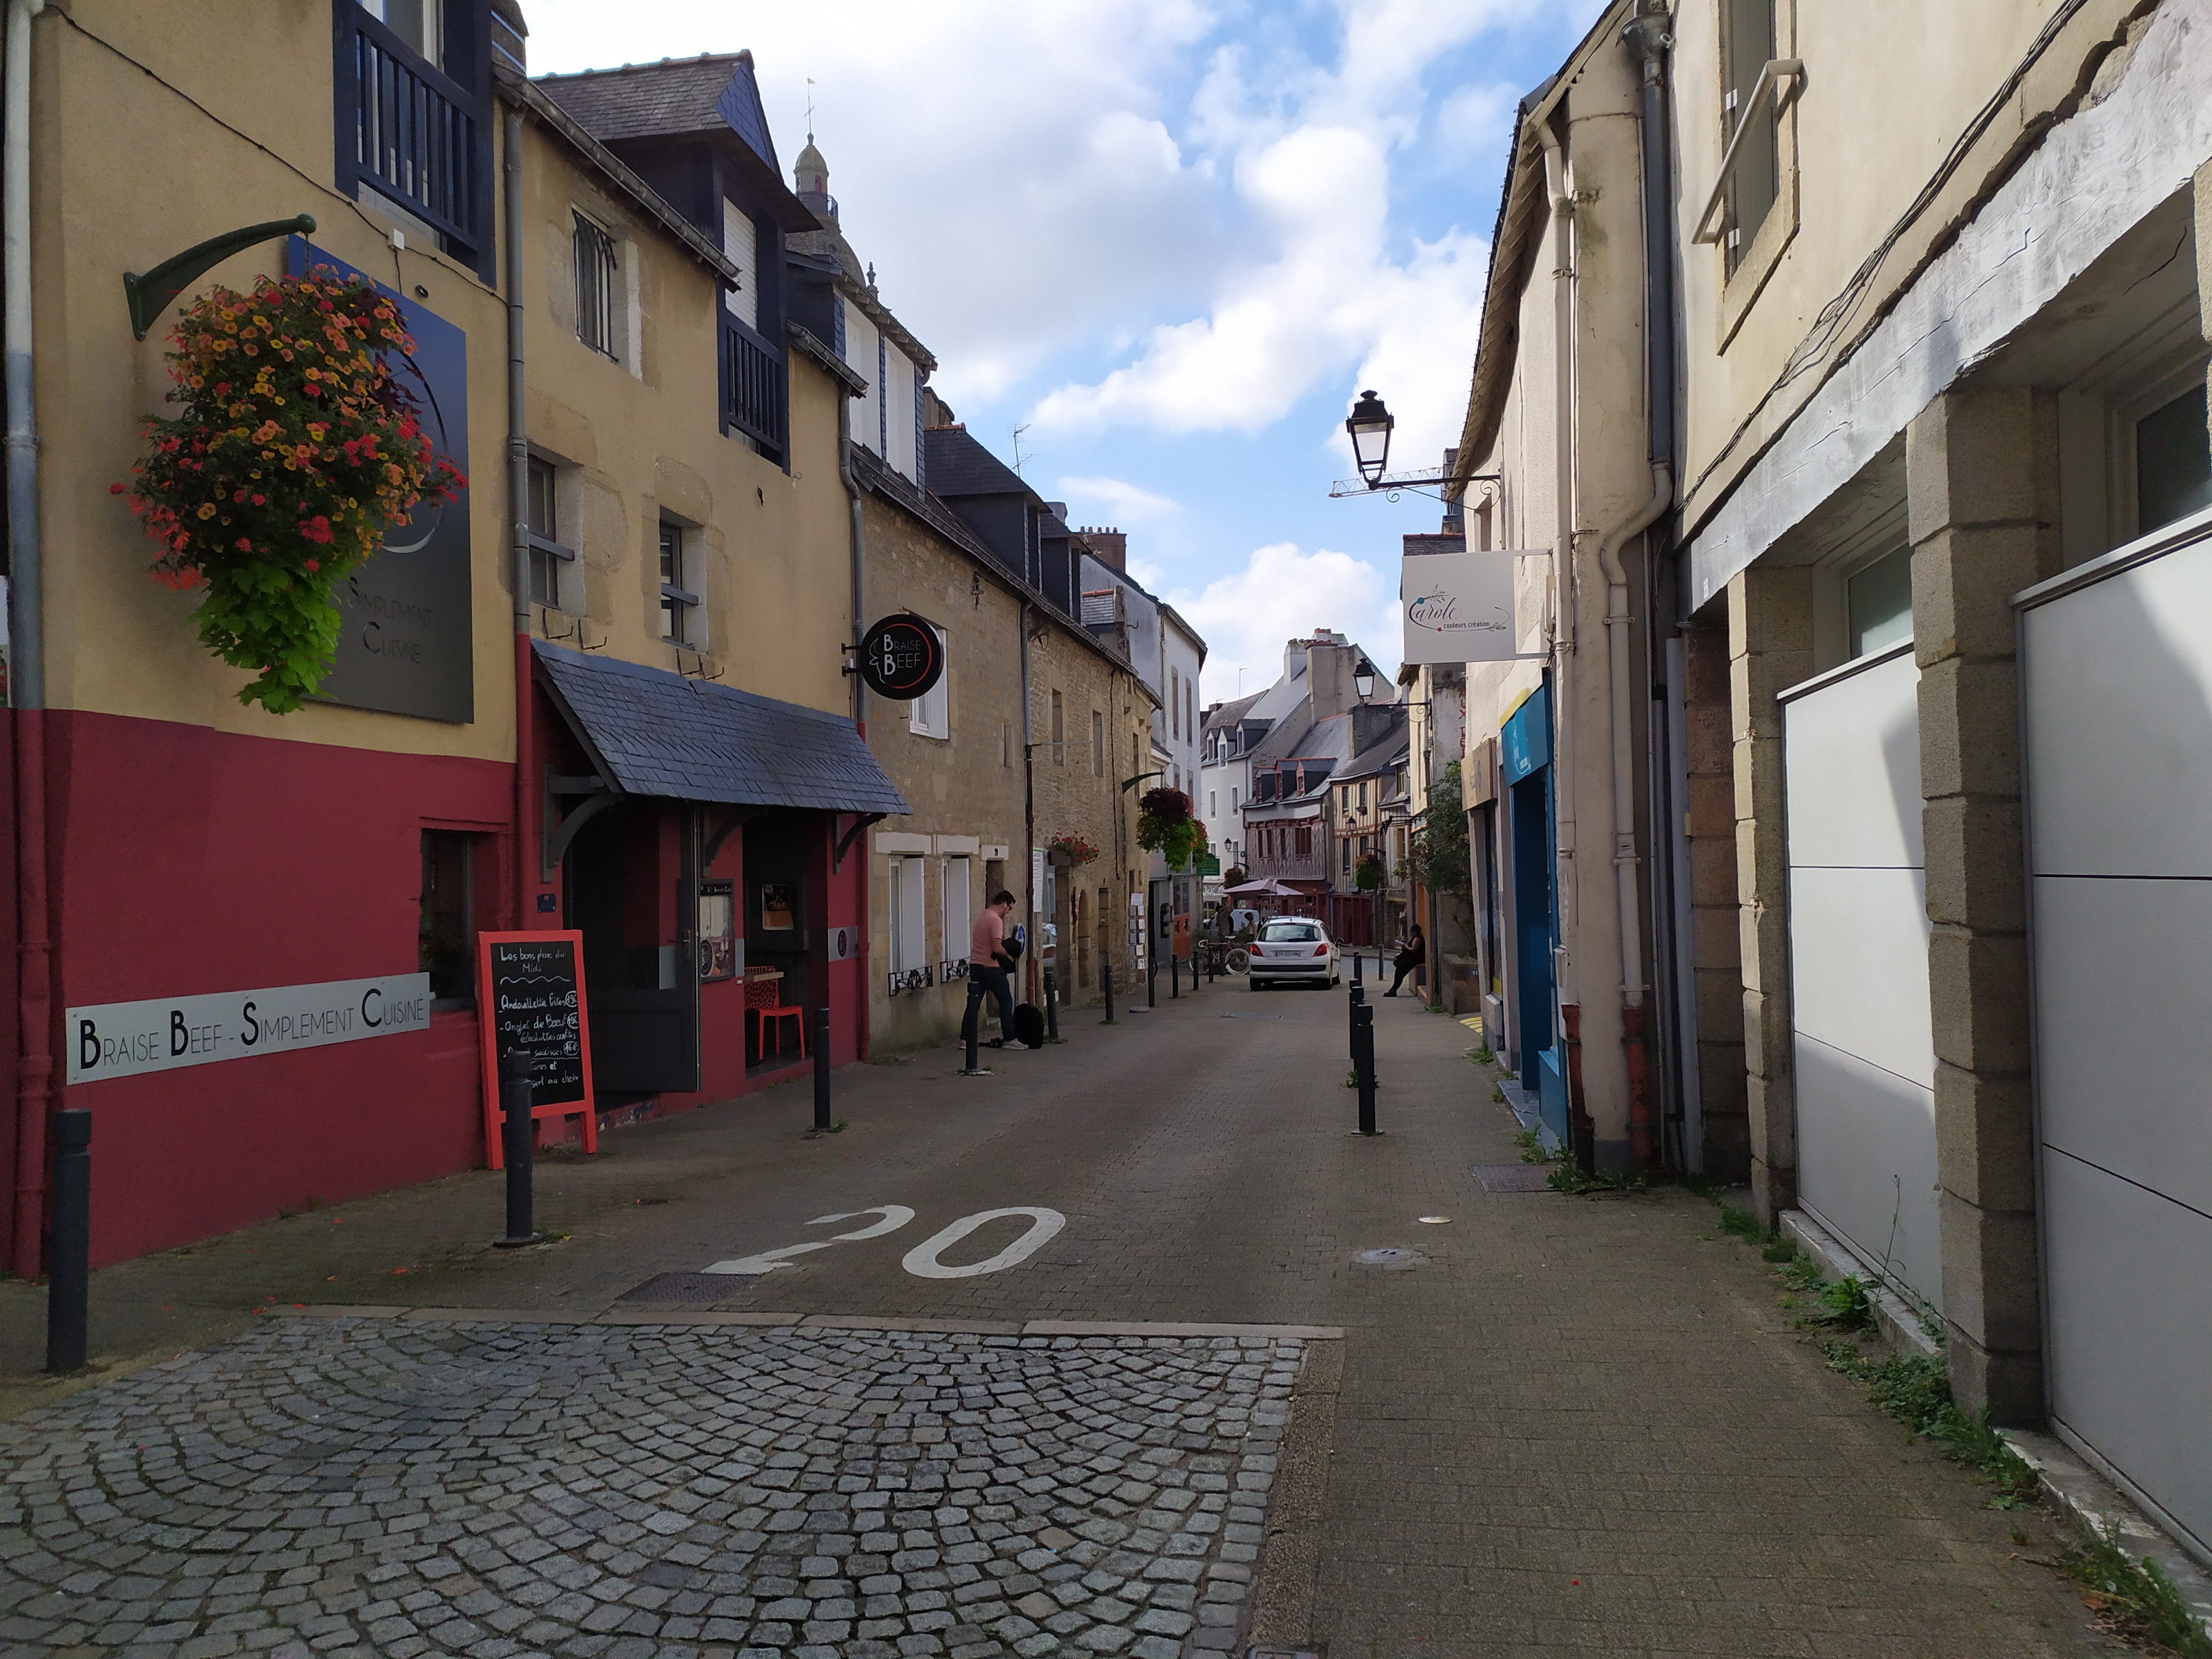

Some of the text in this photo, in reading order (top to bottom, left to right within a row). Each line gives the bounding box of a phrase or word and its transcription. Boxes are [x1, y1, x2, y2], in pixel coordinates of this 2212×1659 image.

[884, 634, 921, 651] BRAISE
[884, 653, 921, 675] BEEF
[500, 946, 518, 961] Les
[519, 947, 535, 960] bons
[555, 949, 565, 959] du
[523, 963, 541, 973] Midi
[80, 1019, 159, 1070] BRAISE
[170, 1010, 222, 1057] BEEF
[241, 1001, 354, 1046] SIMPLEMENT
[361, 988, 424, 1027] CUISINÉ
[533, 1016, 545, 1029] de
[550, 1060, 557, 1071] et
[699, 1204, 1066, 1279] 20
